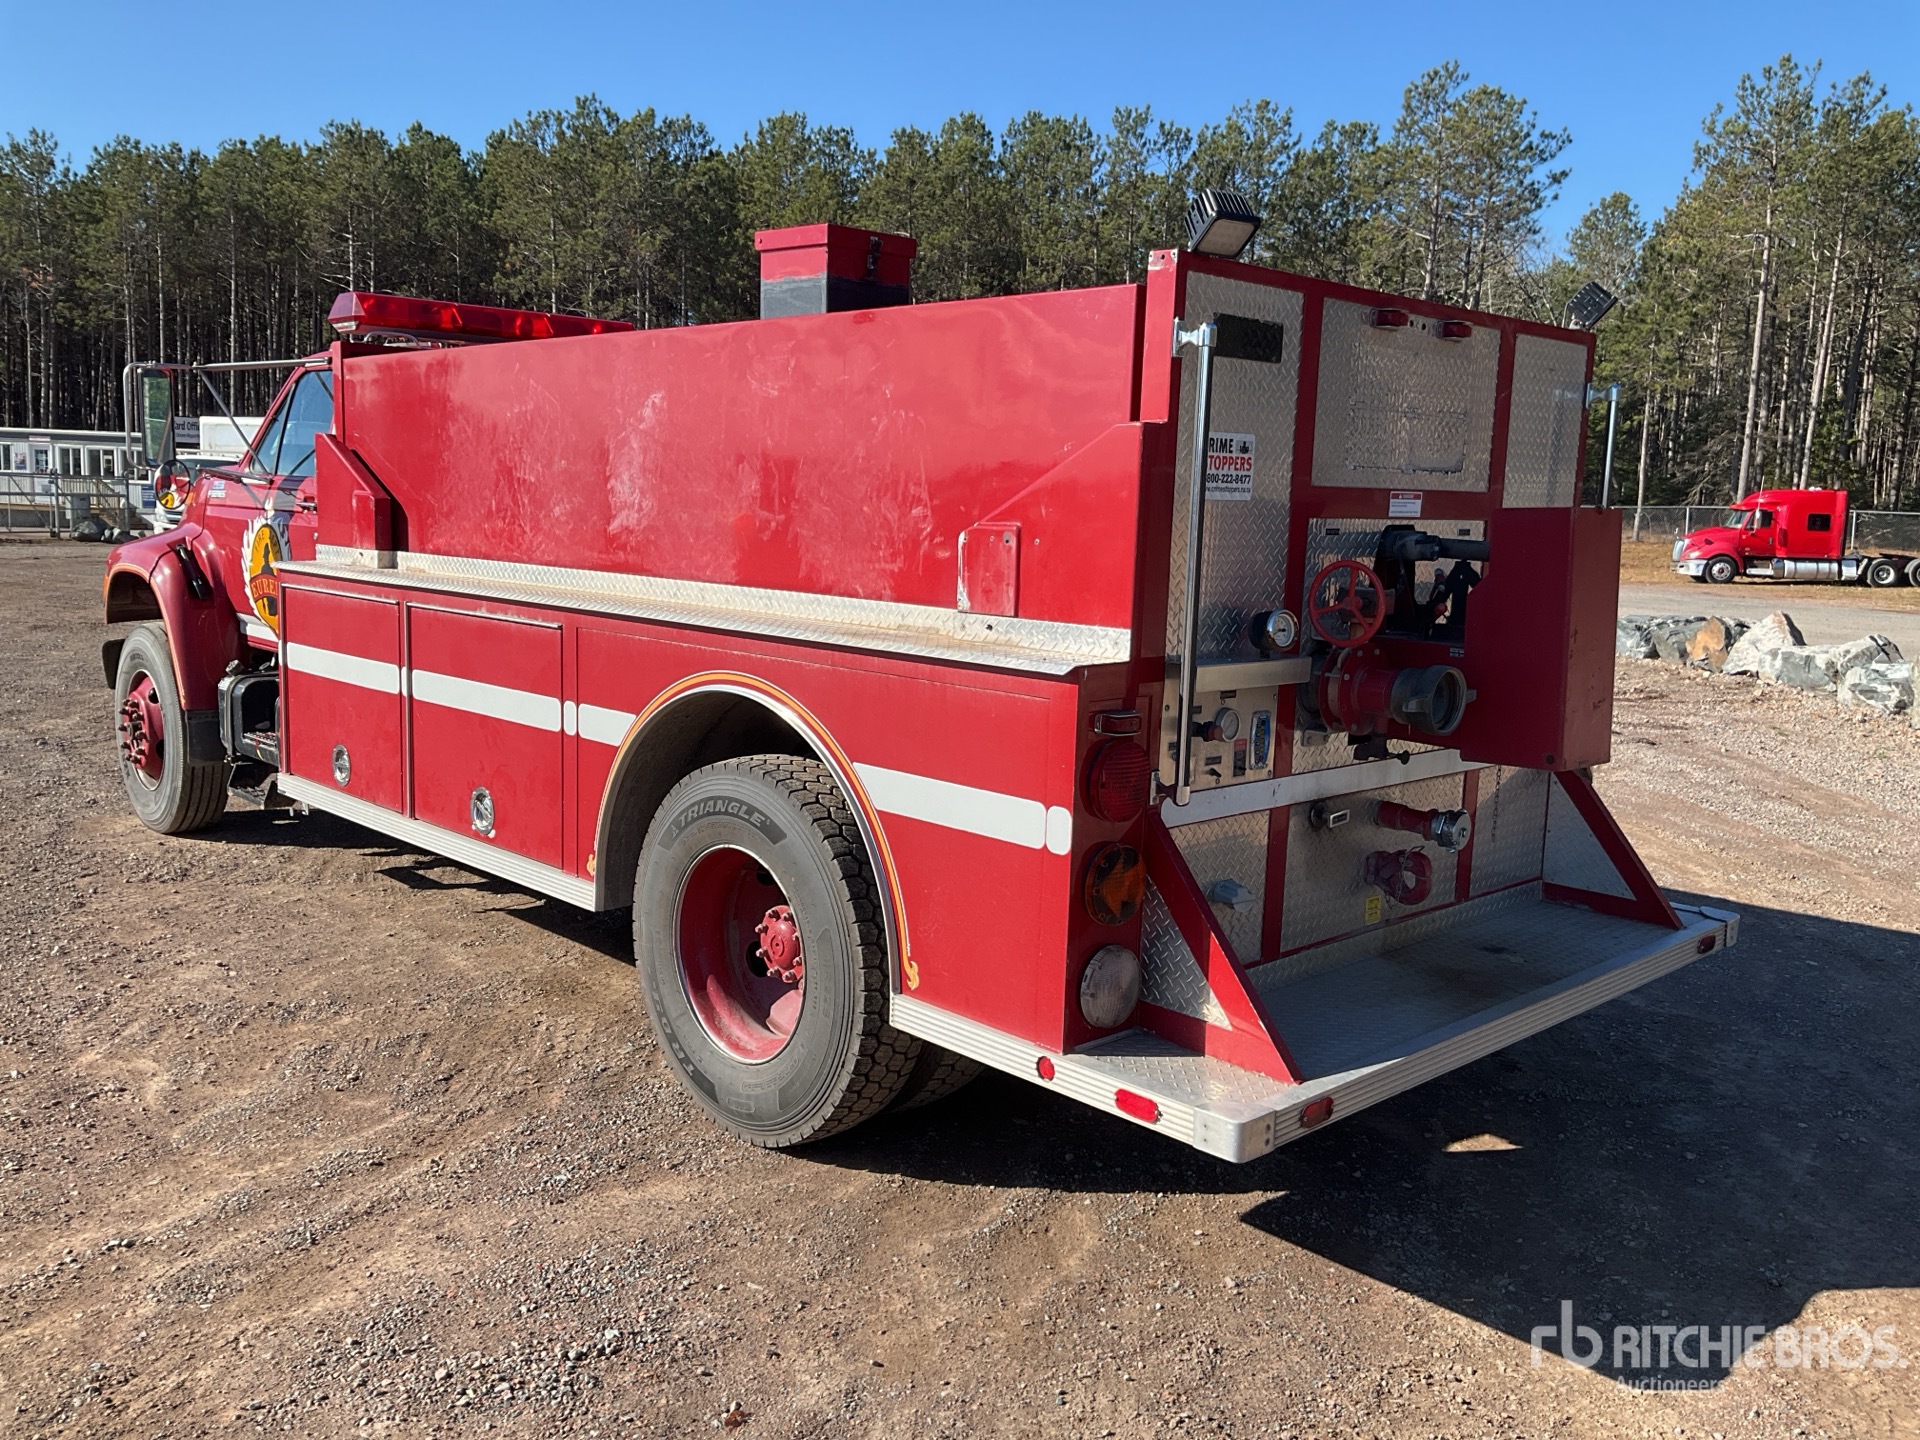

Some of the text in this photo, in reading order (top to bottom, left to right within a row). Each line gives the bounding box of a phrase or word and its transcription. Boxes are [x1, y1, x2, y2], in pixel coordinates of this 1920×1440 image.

[175, 421, 185, 431] ard
[1209, 437, 1234, 453] RIME
[1208, 455, 1253, 472] TOPPERS
[1206, 473, 1251, 484] 800-222-8477
[254, 529, 265, 552] FIRE
[678, 799, 766, 828] TRIANGLE
